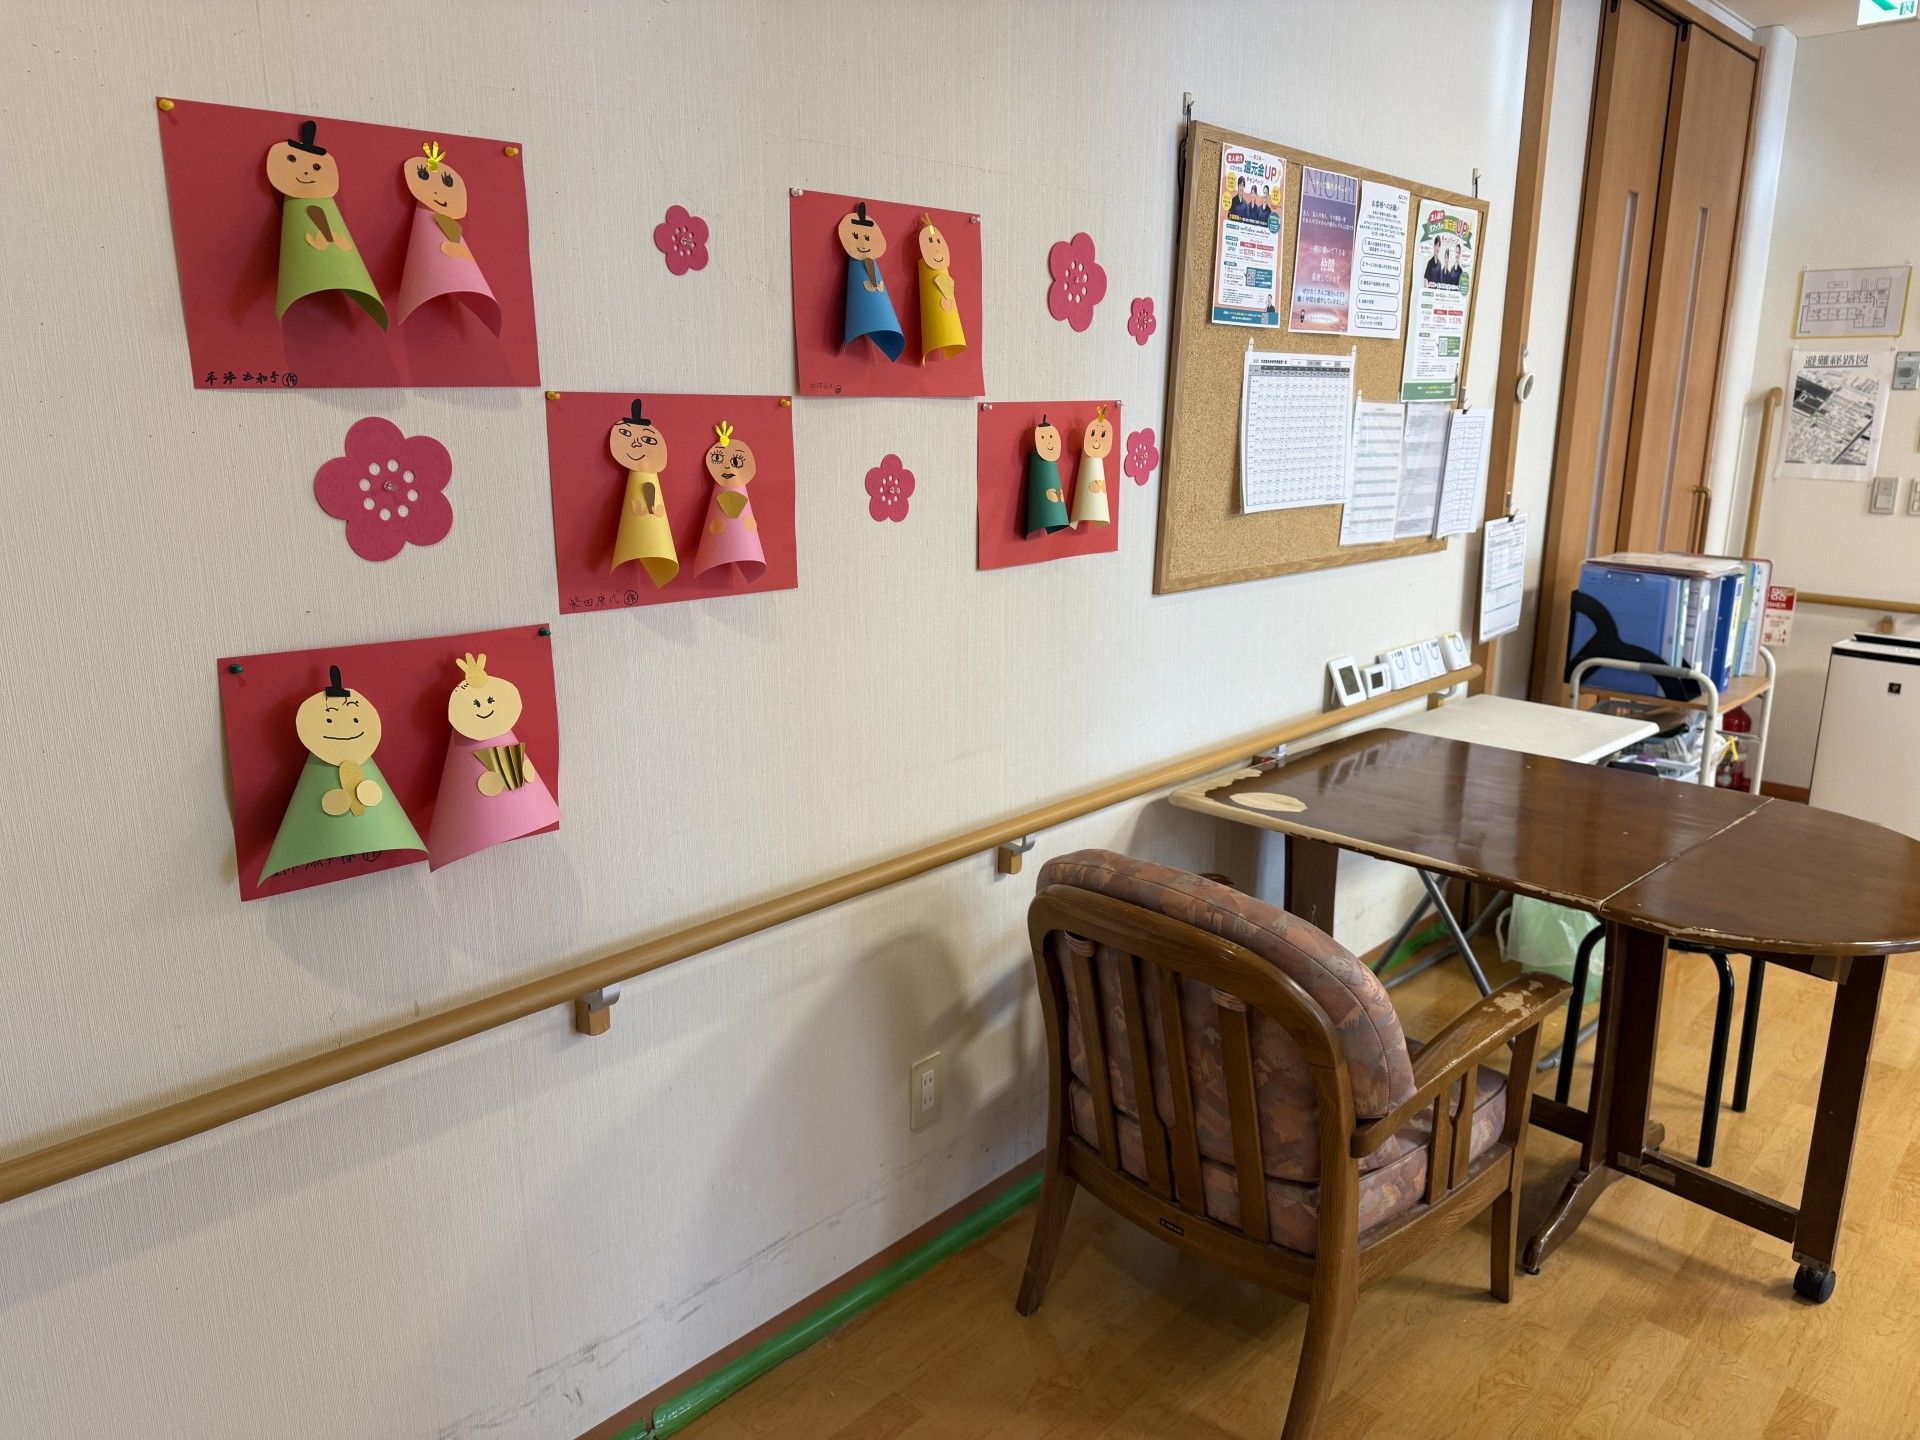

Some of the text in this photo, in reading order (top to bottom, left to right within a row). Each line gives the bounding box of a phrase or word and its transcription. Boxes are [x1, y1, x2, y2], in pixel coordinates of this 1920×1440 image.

[1246, 176, 1264, 186] キャンペーン
[1805, 354, 1869, 366] 避難経路図
